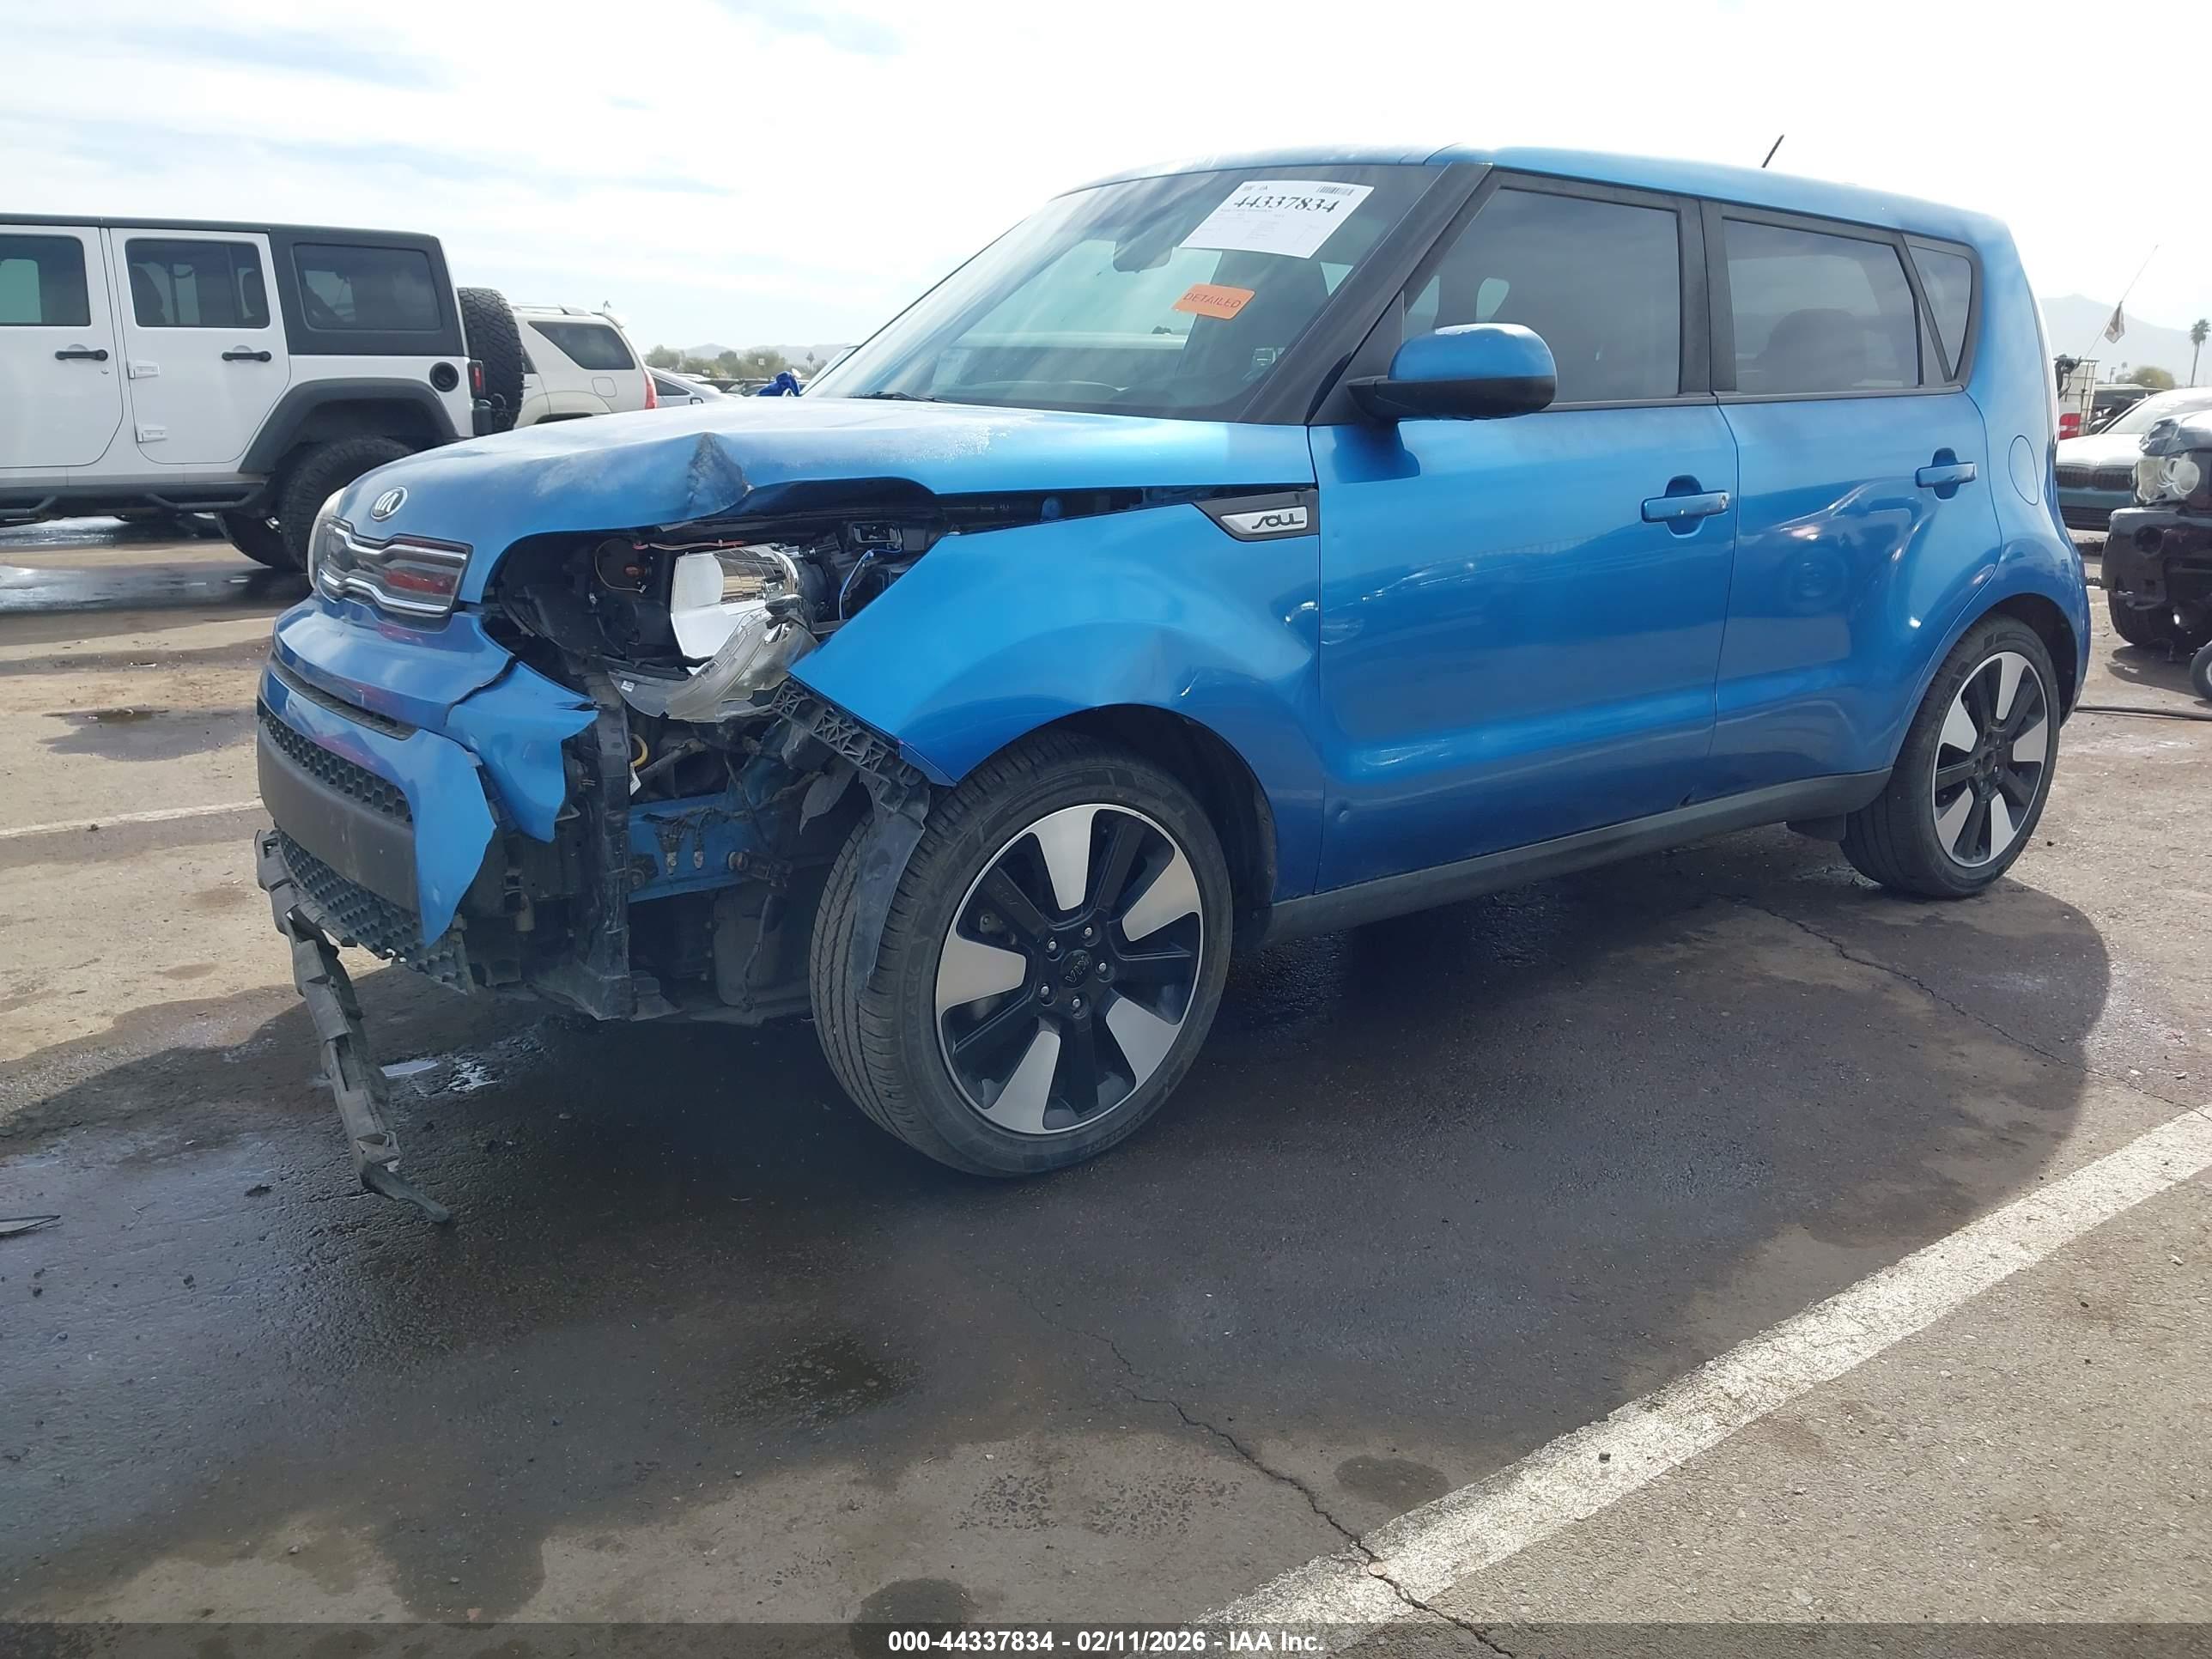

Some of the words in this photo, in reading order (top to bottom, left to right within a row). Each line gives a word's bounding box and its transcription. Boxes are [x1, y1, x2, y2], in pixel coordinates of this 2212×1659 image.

[1233, 195, 1340, 214] 44337834
[1183, 292, 1242, 308] DETAILED
[1251, 513, 1304, 529] SOUL
